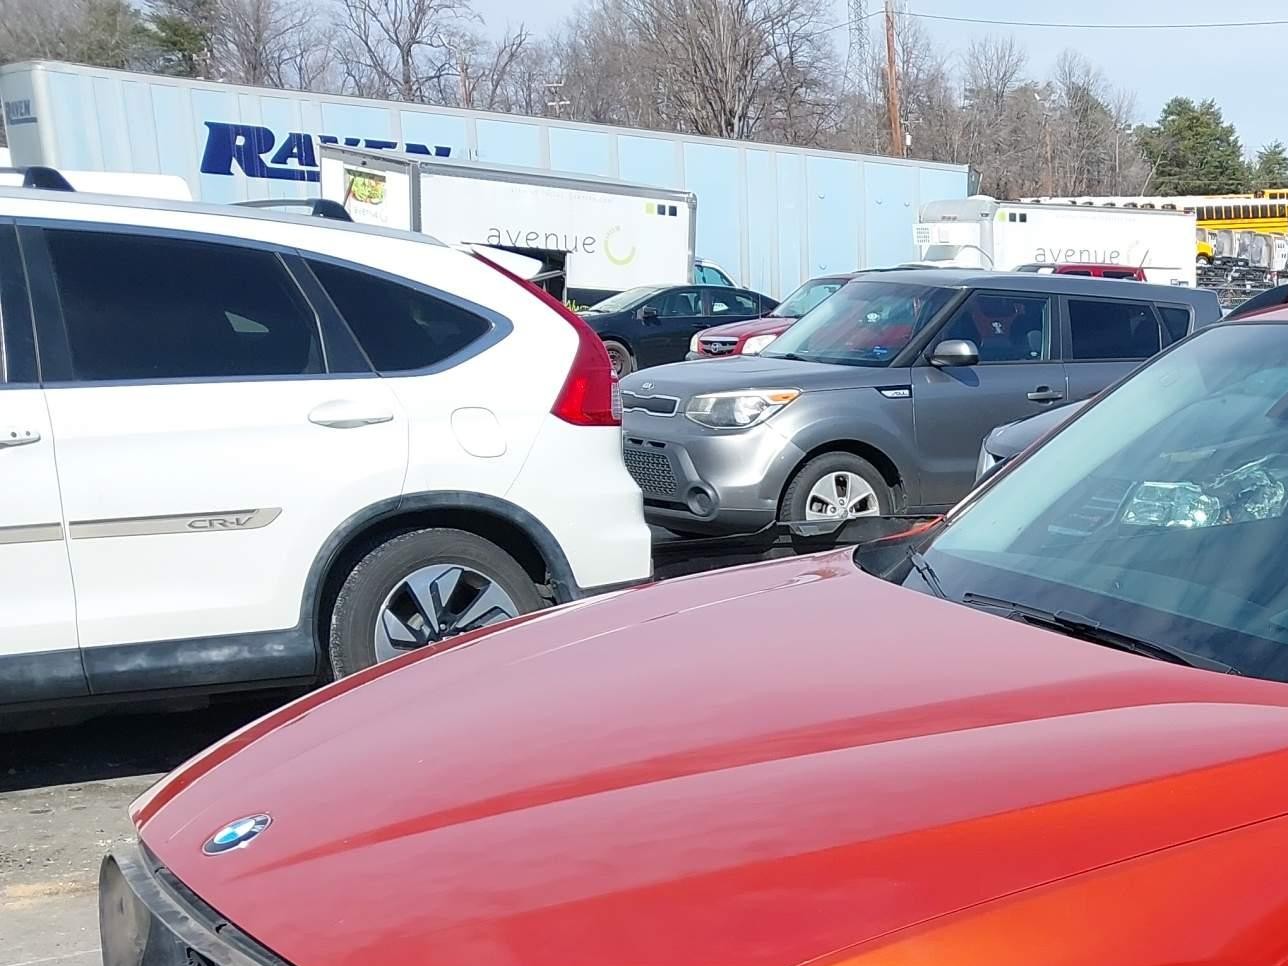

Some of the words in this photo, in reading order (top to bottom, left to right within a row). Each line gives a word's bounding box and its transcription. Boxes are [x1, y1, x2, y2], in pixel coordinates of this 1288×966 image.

[486, 227, 596, 254] avenue
[1034, 247, 1121, 265] avenue
[187, 516, 254, 529] CR-V
